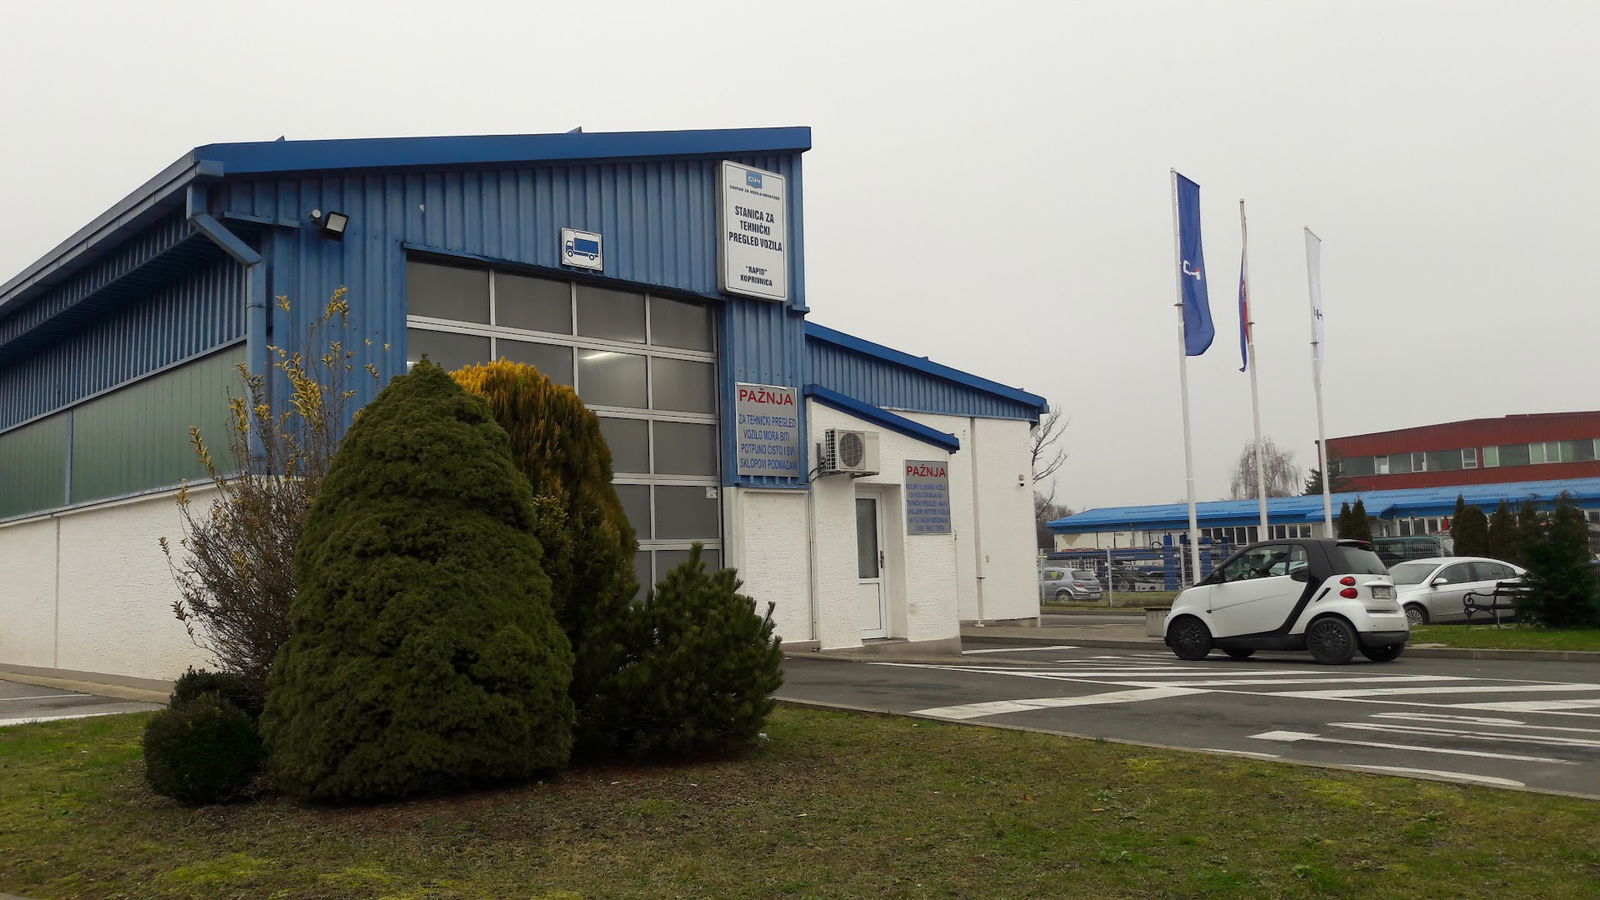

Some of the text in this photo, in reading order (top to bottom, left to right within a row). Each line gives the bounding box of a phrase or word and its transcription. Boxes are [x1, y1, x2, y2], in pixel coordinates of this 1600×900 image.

[734, 205, 775, 224] STANICA ZA
[740, 220, 771, 236] TEHNIČKI
[728, 231, 783, 252] PREGLED VOZILA
[740, 274, 773, 287] KOPRIVNICA
[739, 388, 793, 406] PAŽNJA
[738, 413, 796, 428] ZA TEHNIČKI PREGLED
[743, 428, 790, 442] VOZILO MORA BITI
[741, 443, 767, 455] POTPUNO
[740, 457, 767, 469] SKLOPOVI
[906, 464, 946, 478] PAŽNJA
